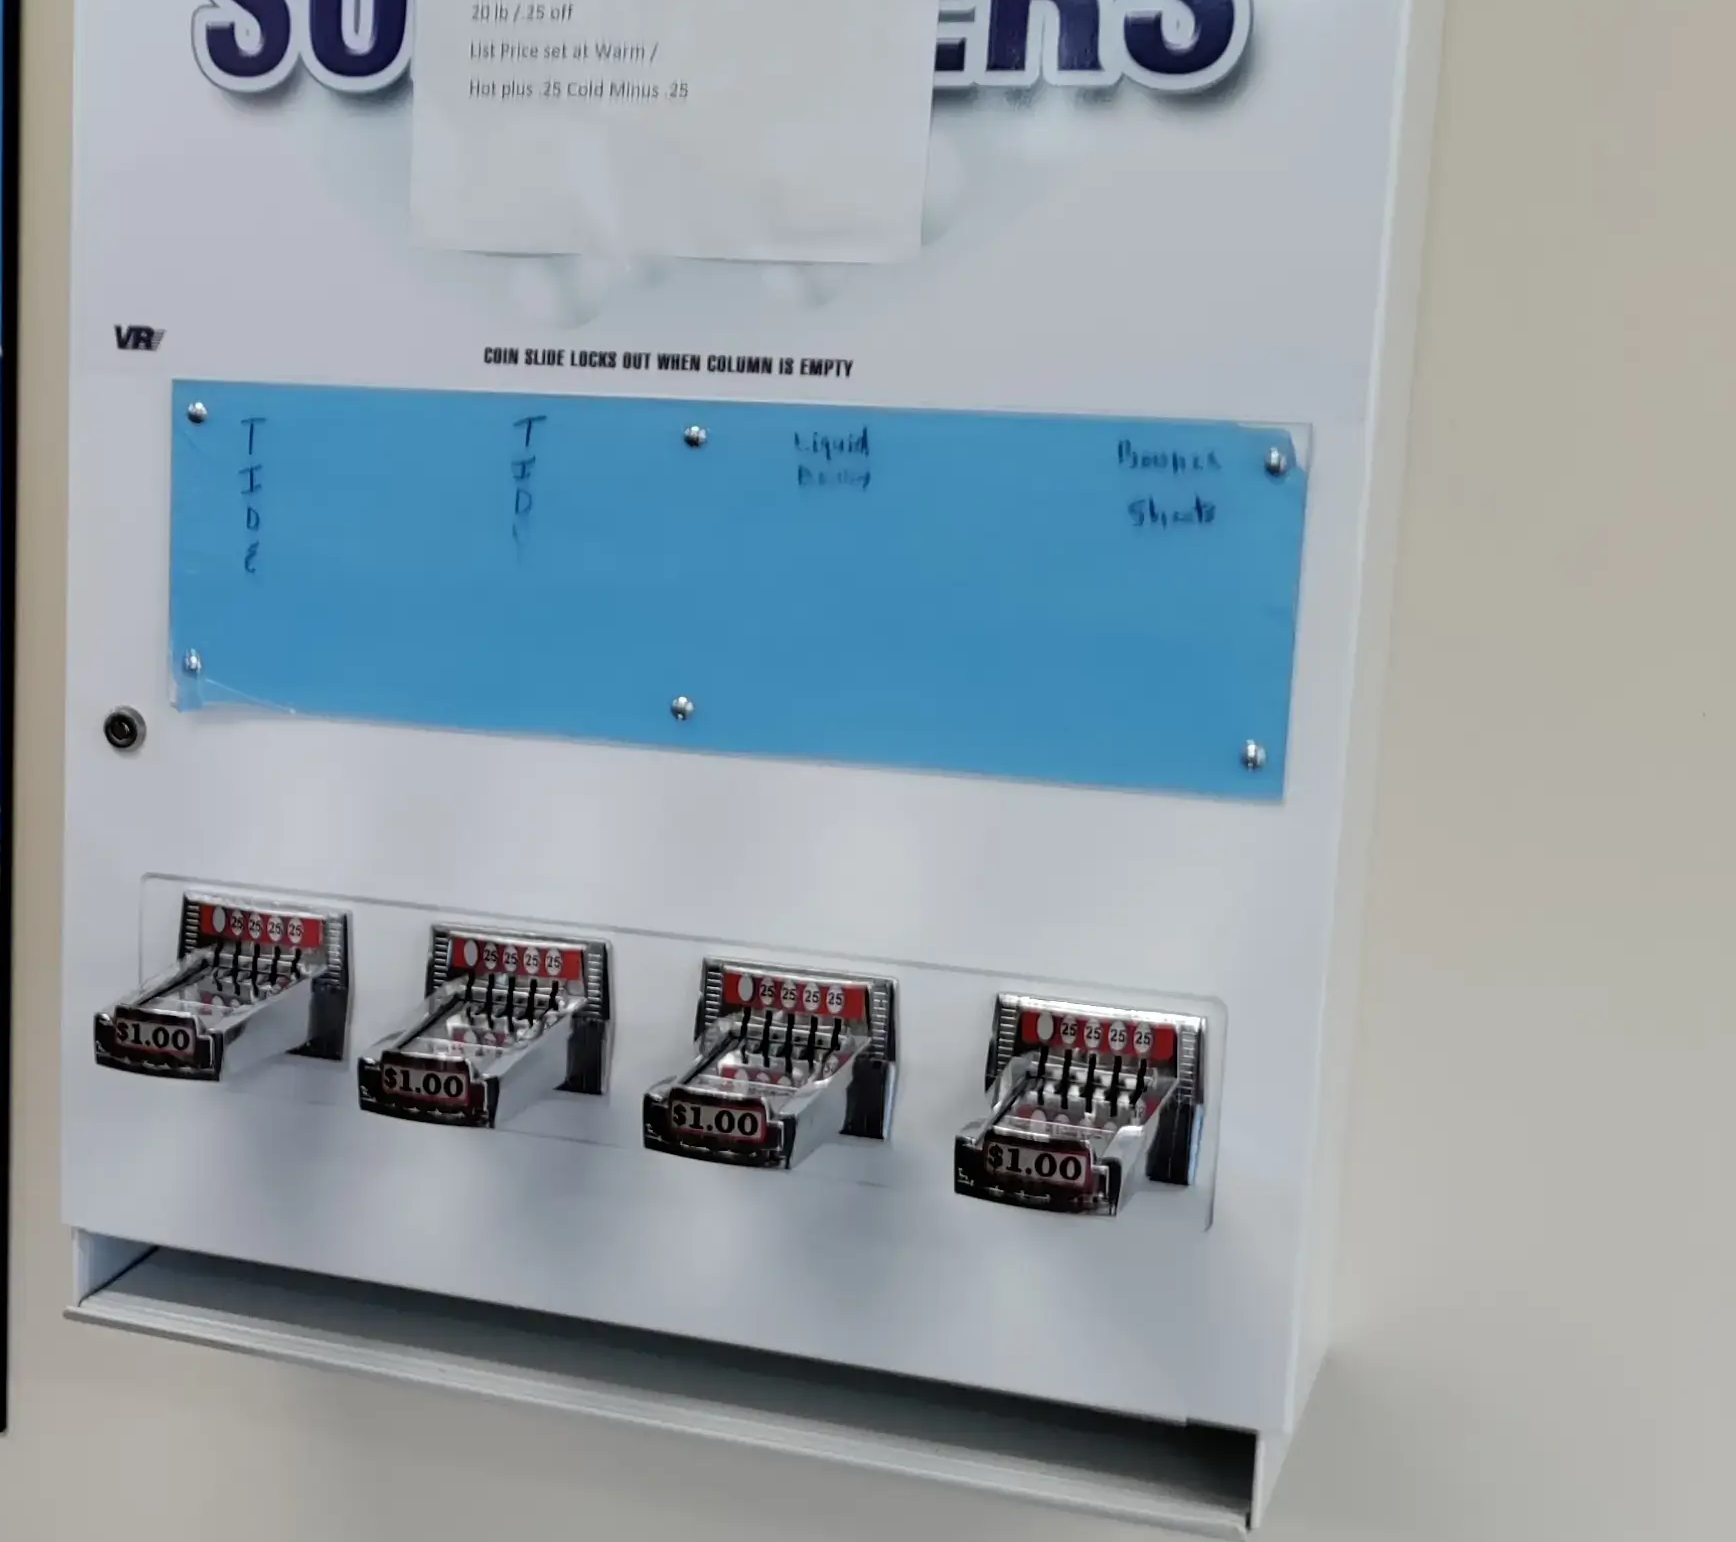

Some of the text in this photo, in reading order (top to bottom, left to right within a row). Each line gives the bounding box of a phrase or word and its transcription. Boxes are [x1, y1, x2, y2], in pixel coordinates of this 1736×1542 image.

[472, 2, 573, 22] 20 lb off
[469, 42, 495, 59] List
[500, 43, 538, 59] Price
[544, 44, 567, 59] set
[573, 43, 588, 59] at
[596, 43, 645, 62] Warm
[469, 80, 496, 98] Hot
[502, 80, 532, 99] plus
[567, 80, 603, 98] Cold
[610, 81, 659, 99] Minus
[484, 346, 854, 378] COIN SLIDE LOCKS OUT WHEN COLUMN IS EMPTY
[794, 425, 870, 461] Liquid
[232, 916, 302, 937] 25 25 25 25
[484, 949, 561, 969] 25 25 25 25
[761, 984, 842, 1006] 25 25 25 25
[117, 1021, 190, 1051] $1.00
[1062, 1022, 1150, 1045] 25 25 25 25
[384, 1067, 464, 1099] $1.00
[672, 1102, 760, 1137] $1.00
[987, 1145, 1083, 1181] $1.00
